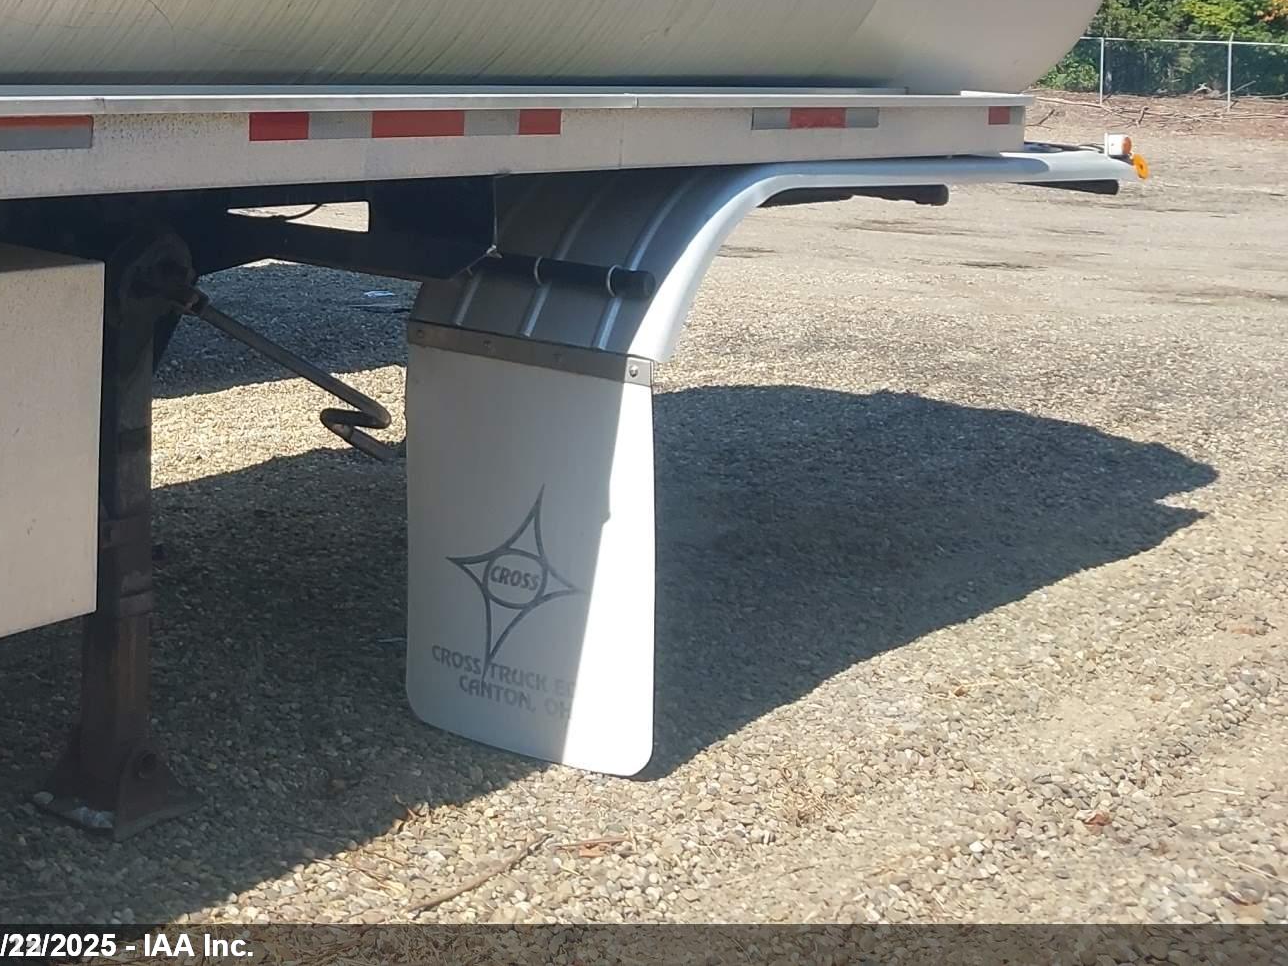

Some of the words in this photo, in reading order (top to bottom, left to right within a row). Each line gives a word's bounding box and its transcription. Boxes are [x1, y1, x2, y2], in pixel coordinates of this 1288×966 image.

[490, 566, 540, 591] CROSS
[431, 645, 482, 675] CROSS
[487, 662, 548, 692] TRUCK
[459, 675, 537, 712] CANTON,
